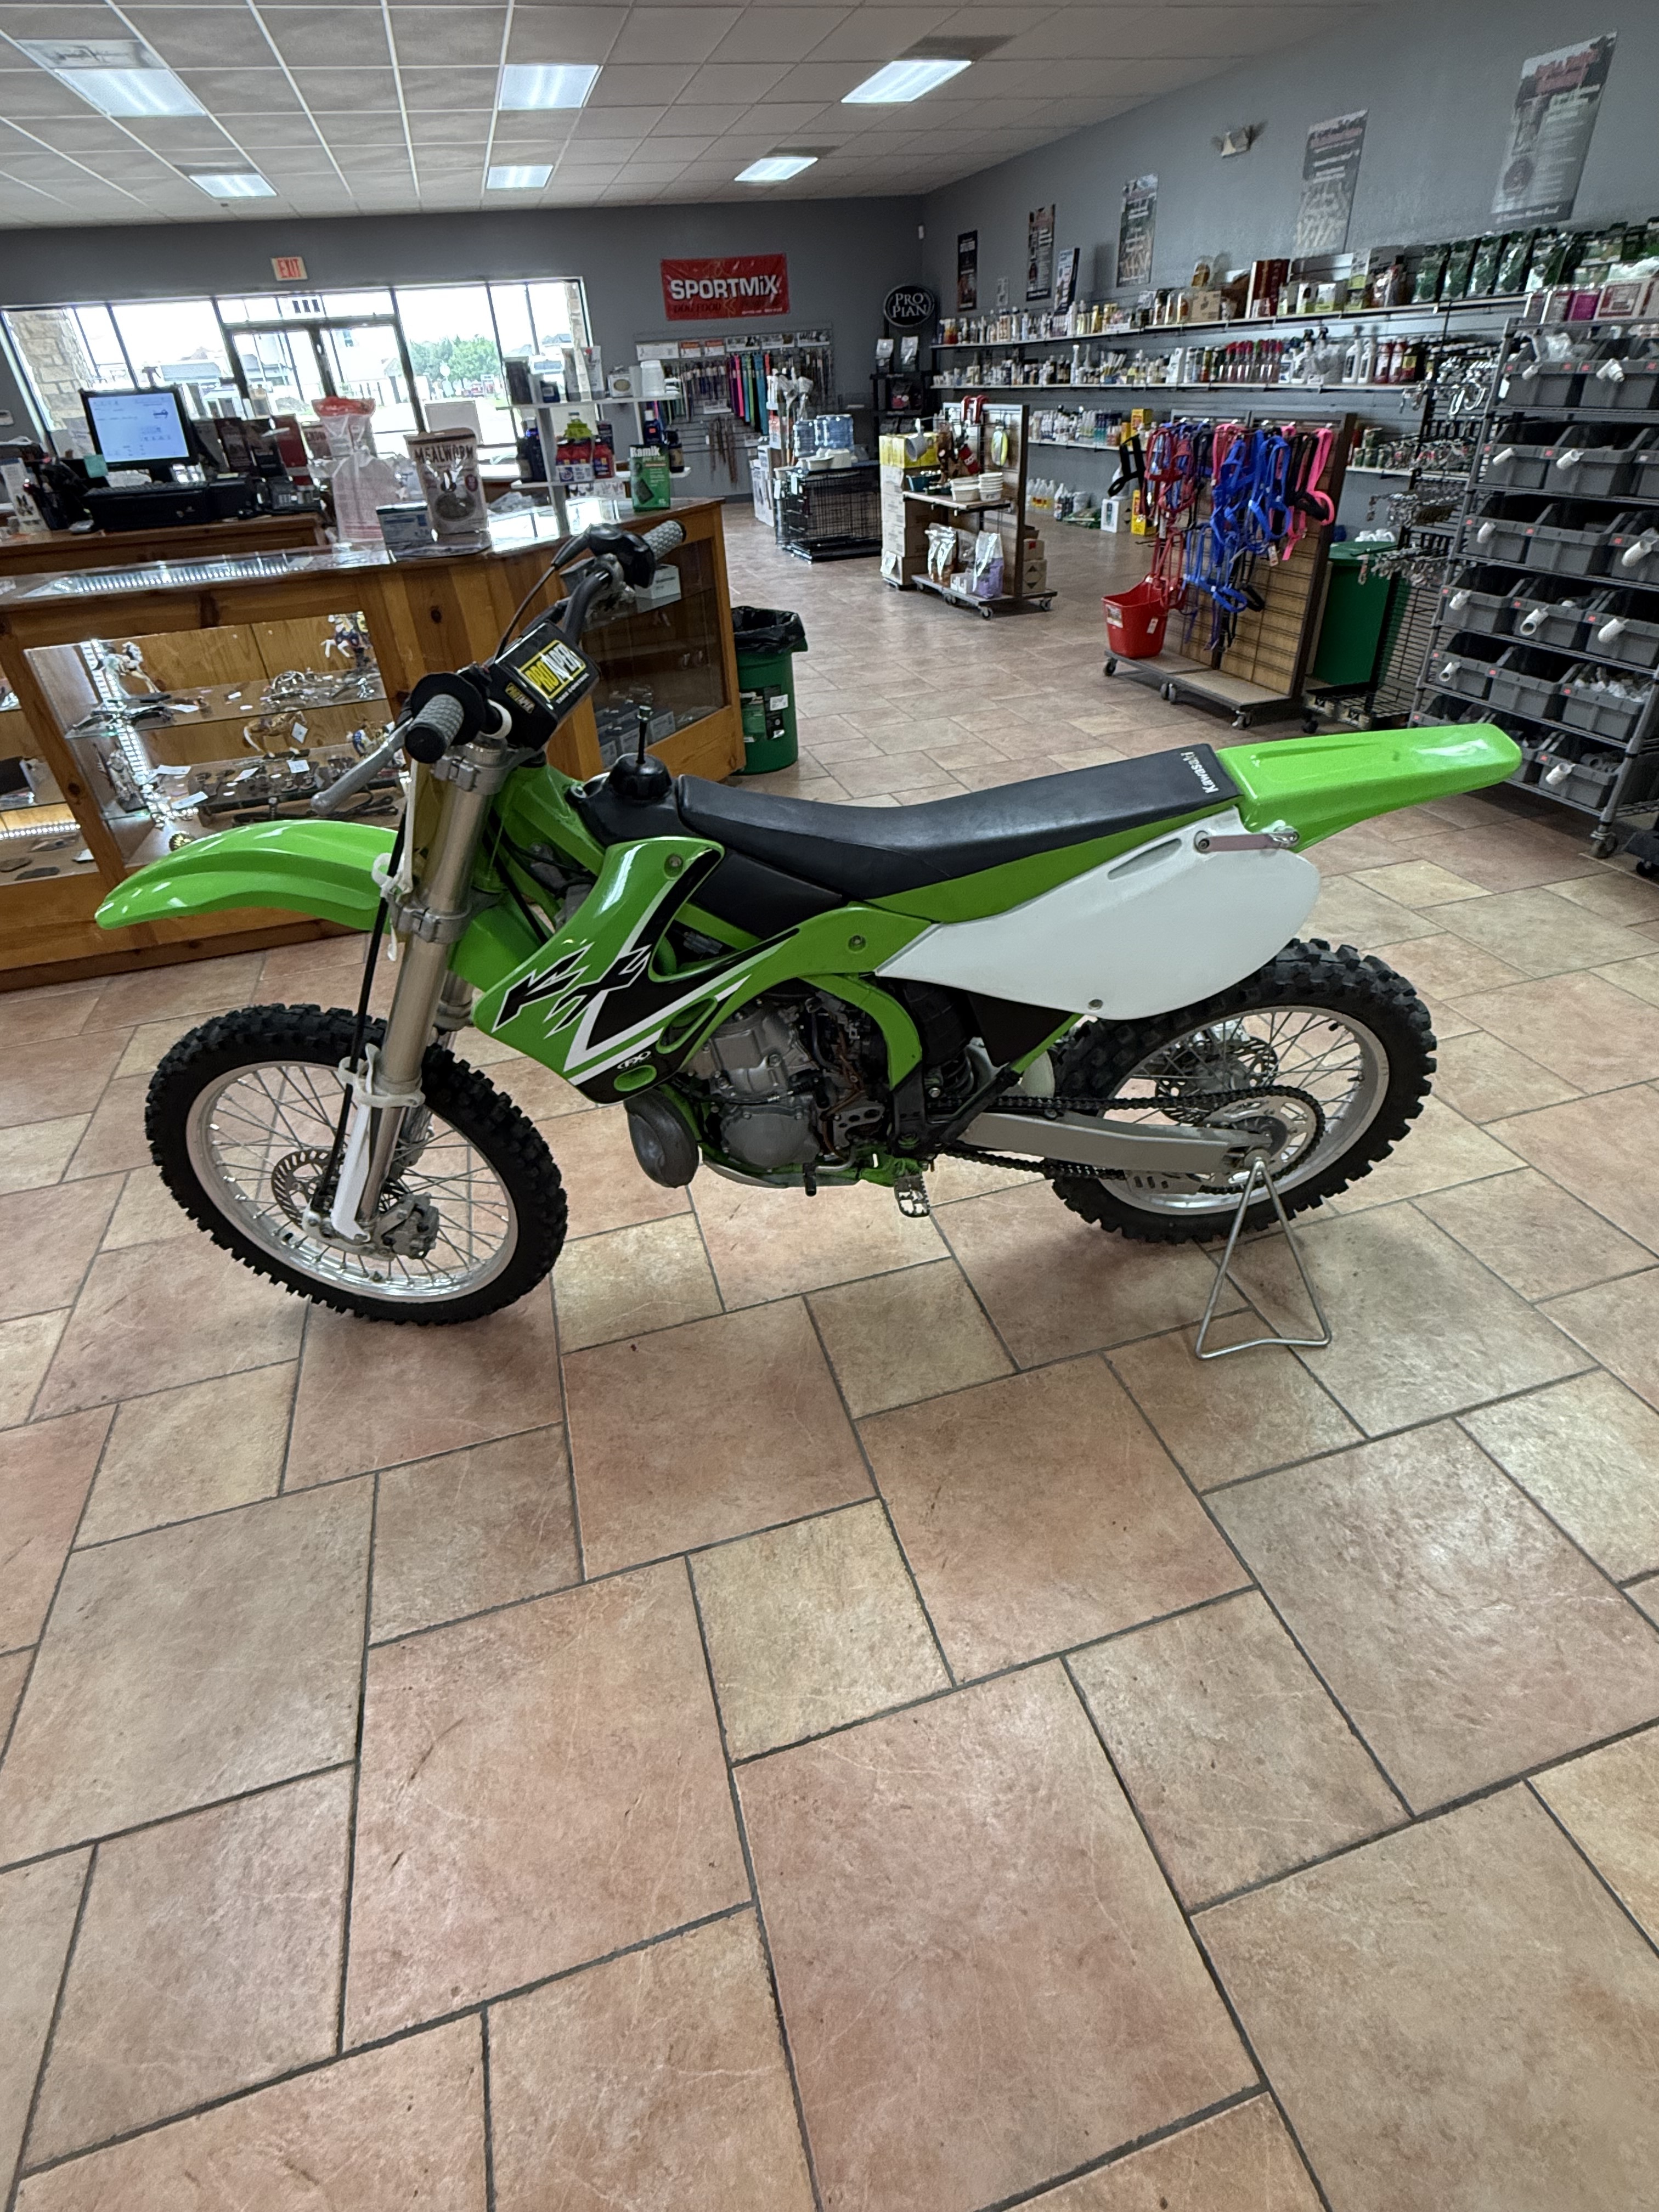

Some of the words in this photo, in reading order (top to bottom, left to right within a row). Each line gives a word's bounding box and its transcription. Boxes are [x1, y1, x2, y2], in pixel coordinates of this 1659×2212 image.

[276, 258, 302, 278] EXIT
[895, 292, 924, 306] PRO
[891, 304, 927, 318] PLAN
